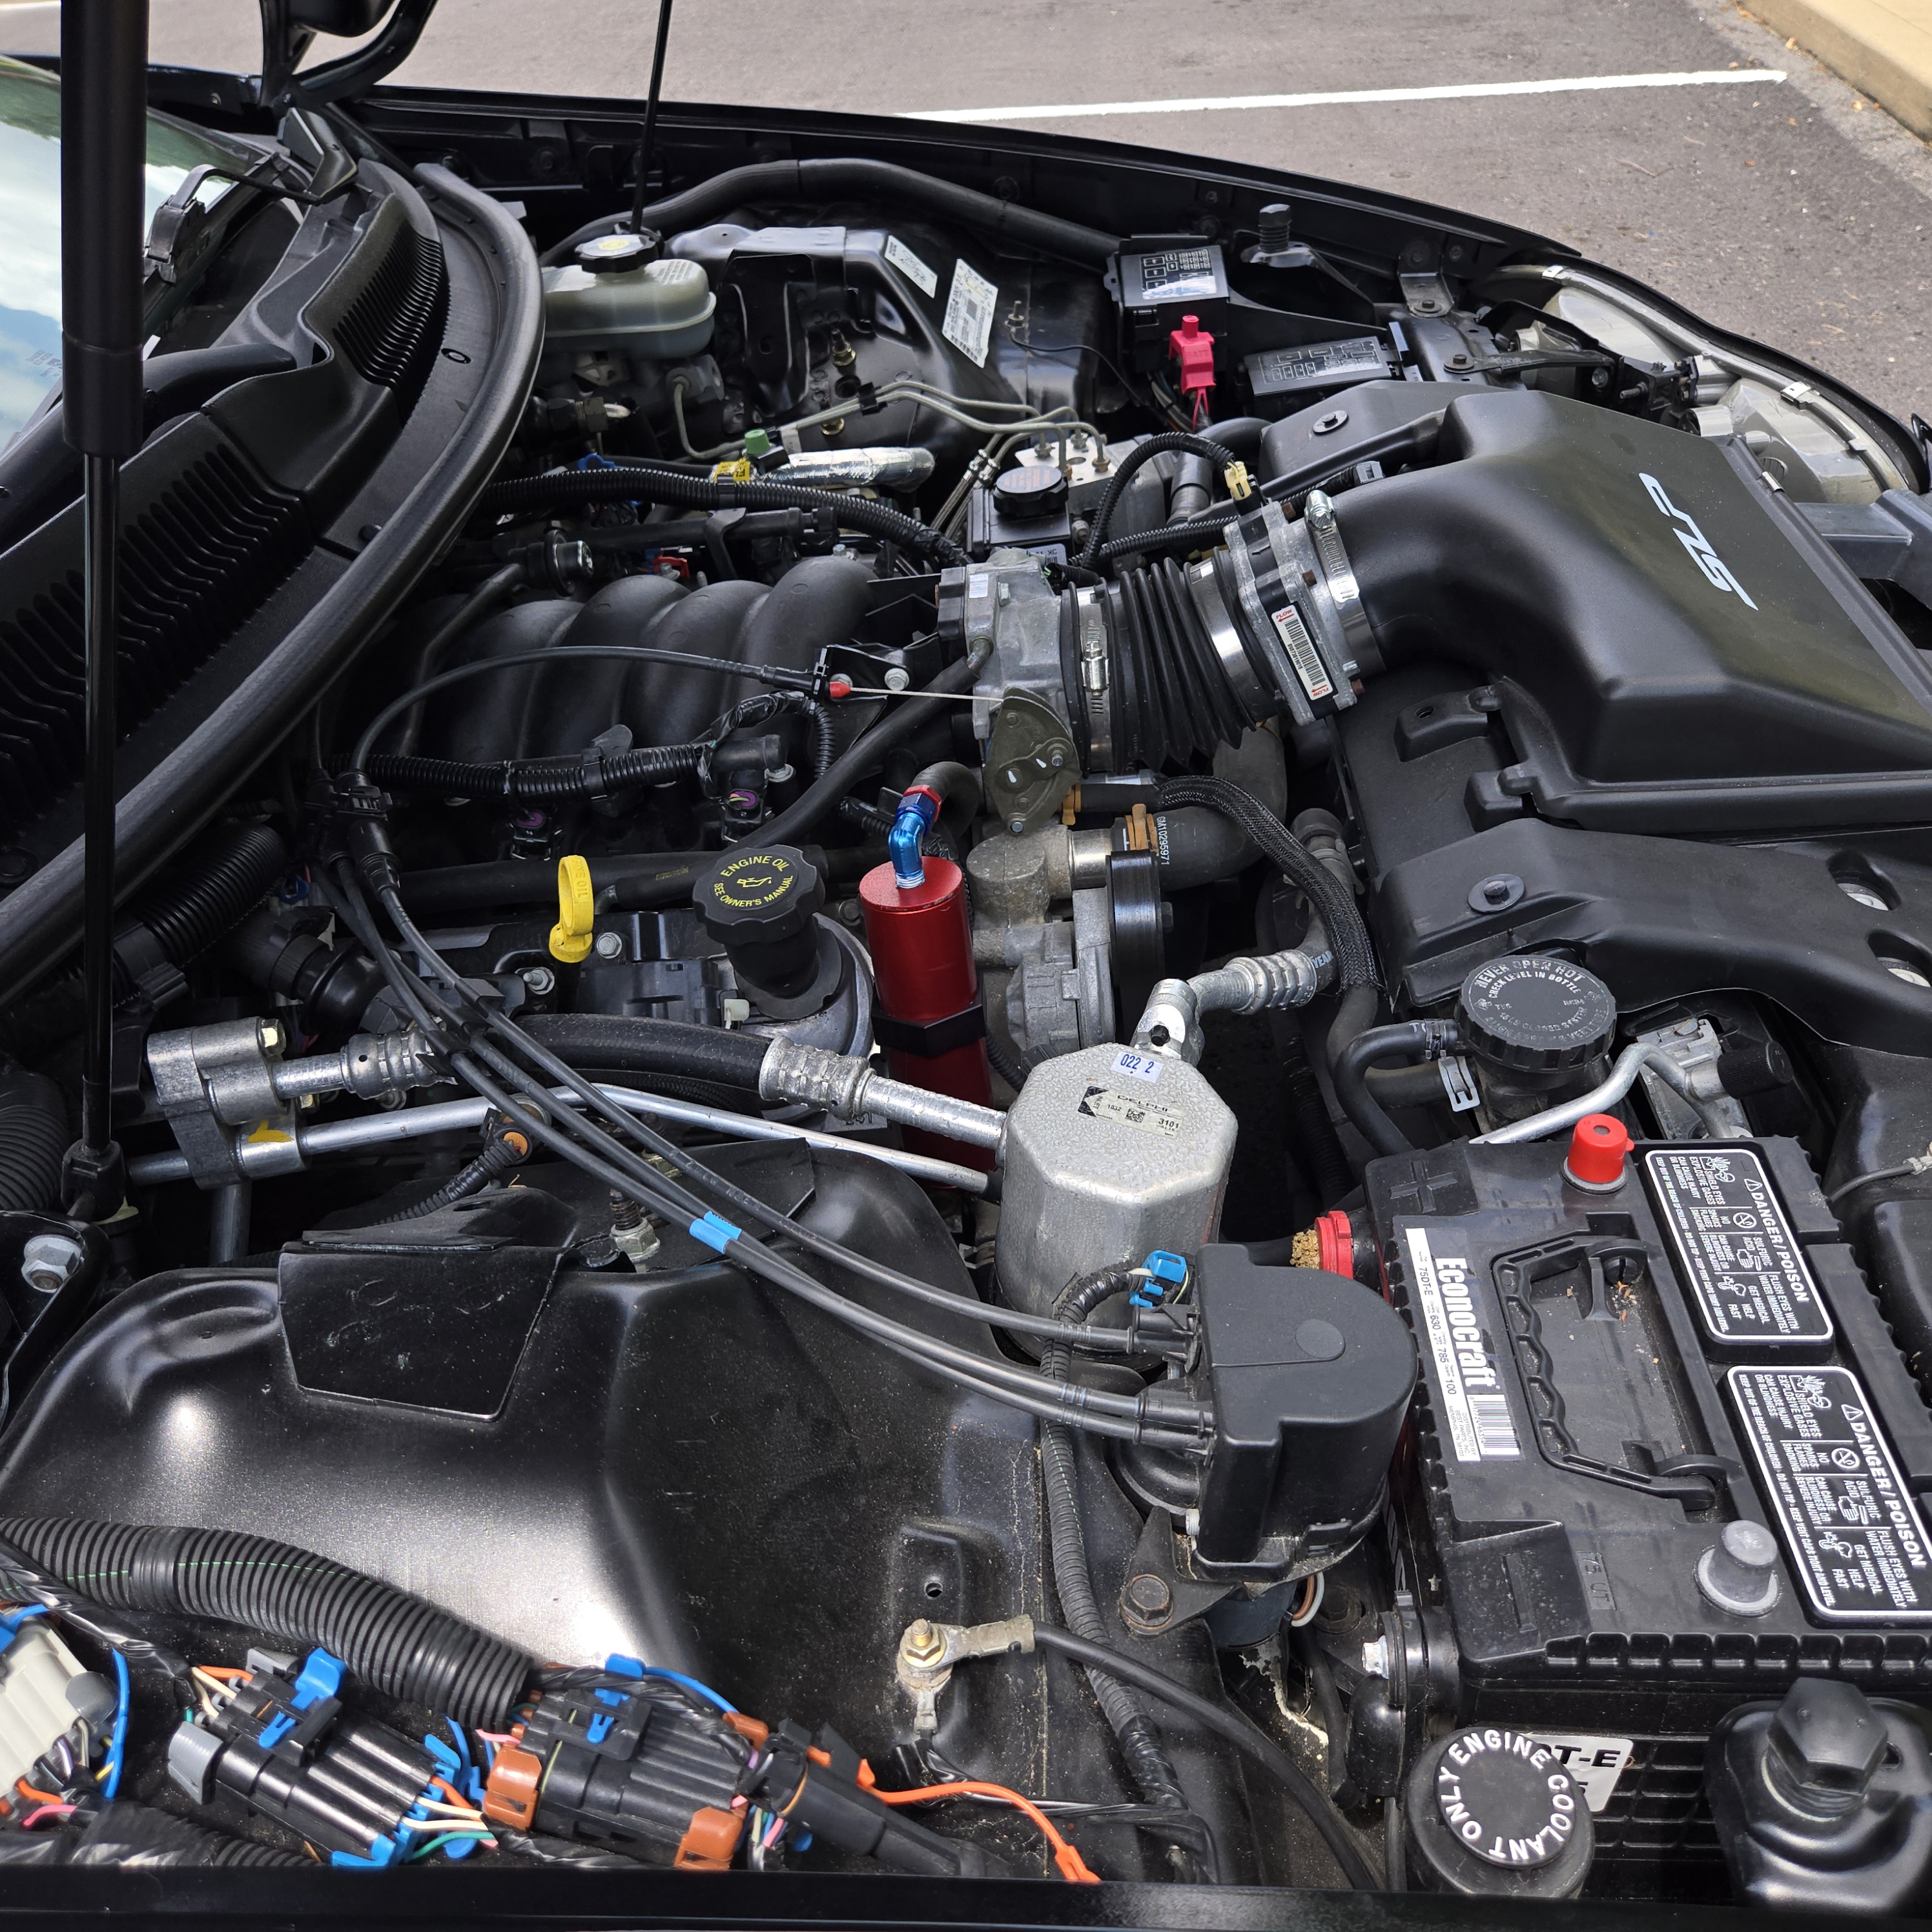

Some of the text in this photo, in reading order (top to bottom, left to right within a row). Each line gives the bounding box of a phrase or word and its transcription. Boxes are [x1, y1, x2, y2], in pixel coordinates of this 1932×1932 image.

[1276, 609, 1292, 619] FLOW
[1313, 687, 1329, 697] FLOW
[1156, 816, 1169, 865] GM10295971
[721, 856, 790, 877] ENGINE OIL
[714, 875, 794, 907] SEE OWNER'S MANUAL
[1474, 963, 1511, 989] NEVER
[1555, 965, 1587, 981] HOT
[1488, 978, 1507, 998] CHECK
[1504, 971, 1532, 981] LEVEL
[1548, 974, 1581, 994] BOTTLE
[1120, 1053, 1155, 1074] 022 2
[1118, 1094, 1168, 1112] DELPHI
[1158, 1118, 1179, 1129] 3101
[1688, 1156, 1716, 1204] EXPLOSIVE GASES
[1703, 1171, 1725, 1204] SHIELD EYES
[1690, 1209, 1706, 1231] SMOKING
[1742, 1237, 1756, 1250] ACID
[1752, 1237, 1773, 1266] SULFURIC
[1418, 1267, 1433, 1295] 75DT-E
[1775, 1251, 1809, 1301] POISON
[1727, 1304, 1742, 1319] FAST
[1740, 1304, 1755, 1318] HELP
[1747, 1286, 1771, 1324] GET MEDICAL
[1757, 1275, 1790, 1333] WATER IMMEDIATELY
[1768, 1275, 1800, 1329] FLUSH EYES WITH
[1430, 1315, 1441, 1330] 630
[1434, 1256, 1496, 1388] Econocraft
[1437, 1348, 1449, 1362] 785
[1444, 1379, 1456, 1395] 100
[1757, 1383, 1778, 1416] BLINDNESS
[1763, 1374, 1793, 1428] CAN CAUSE INJURY
[1776, 1375, 1811, 1437] EXPLOSIVE GASES
[1794, 1393, 1822, 1437] SHIELD EYES
[1782, 1443, 1802, 1471] SMOKING
[1791, 1443, 1809, 1467] FLAMES
[1801, 1443, 1819, 1466] SPARKS
[1815, 1452, 1830, 1463] NO
[1794, 1476, 1822, 1523] SEVERE INJURY
[1804, 1477, 1831, 1521] BLINDNESS OR
[1814, 1477, 1837, 1510] CAN CAUSE
[1843, 1480, 1860, 1497] ACID
[1855, 1481, 1882, 1519] SULFURIC
[1882, 1500, 1926, 1567] POISON
[1583, 1556, 1601, 1573] 75
[1831, 1568, 1849, 1588] FAST
[1846, 1568, 1865, 1588] HELP
[1853, 1544, 1884, 1594] GET MEDICAL
[1864, 1530, 1907, 1607] WATER IMMEDIATELY
[1876, 1530, 1918, 1601] FLUSH EYES WITH
[1438, 1729, 1575, 1860] ENGINE COOLANT ONLY
